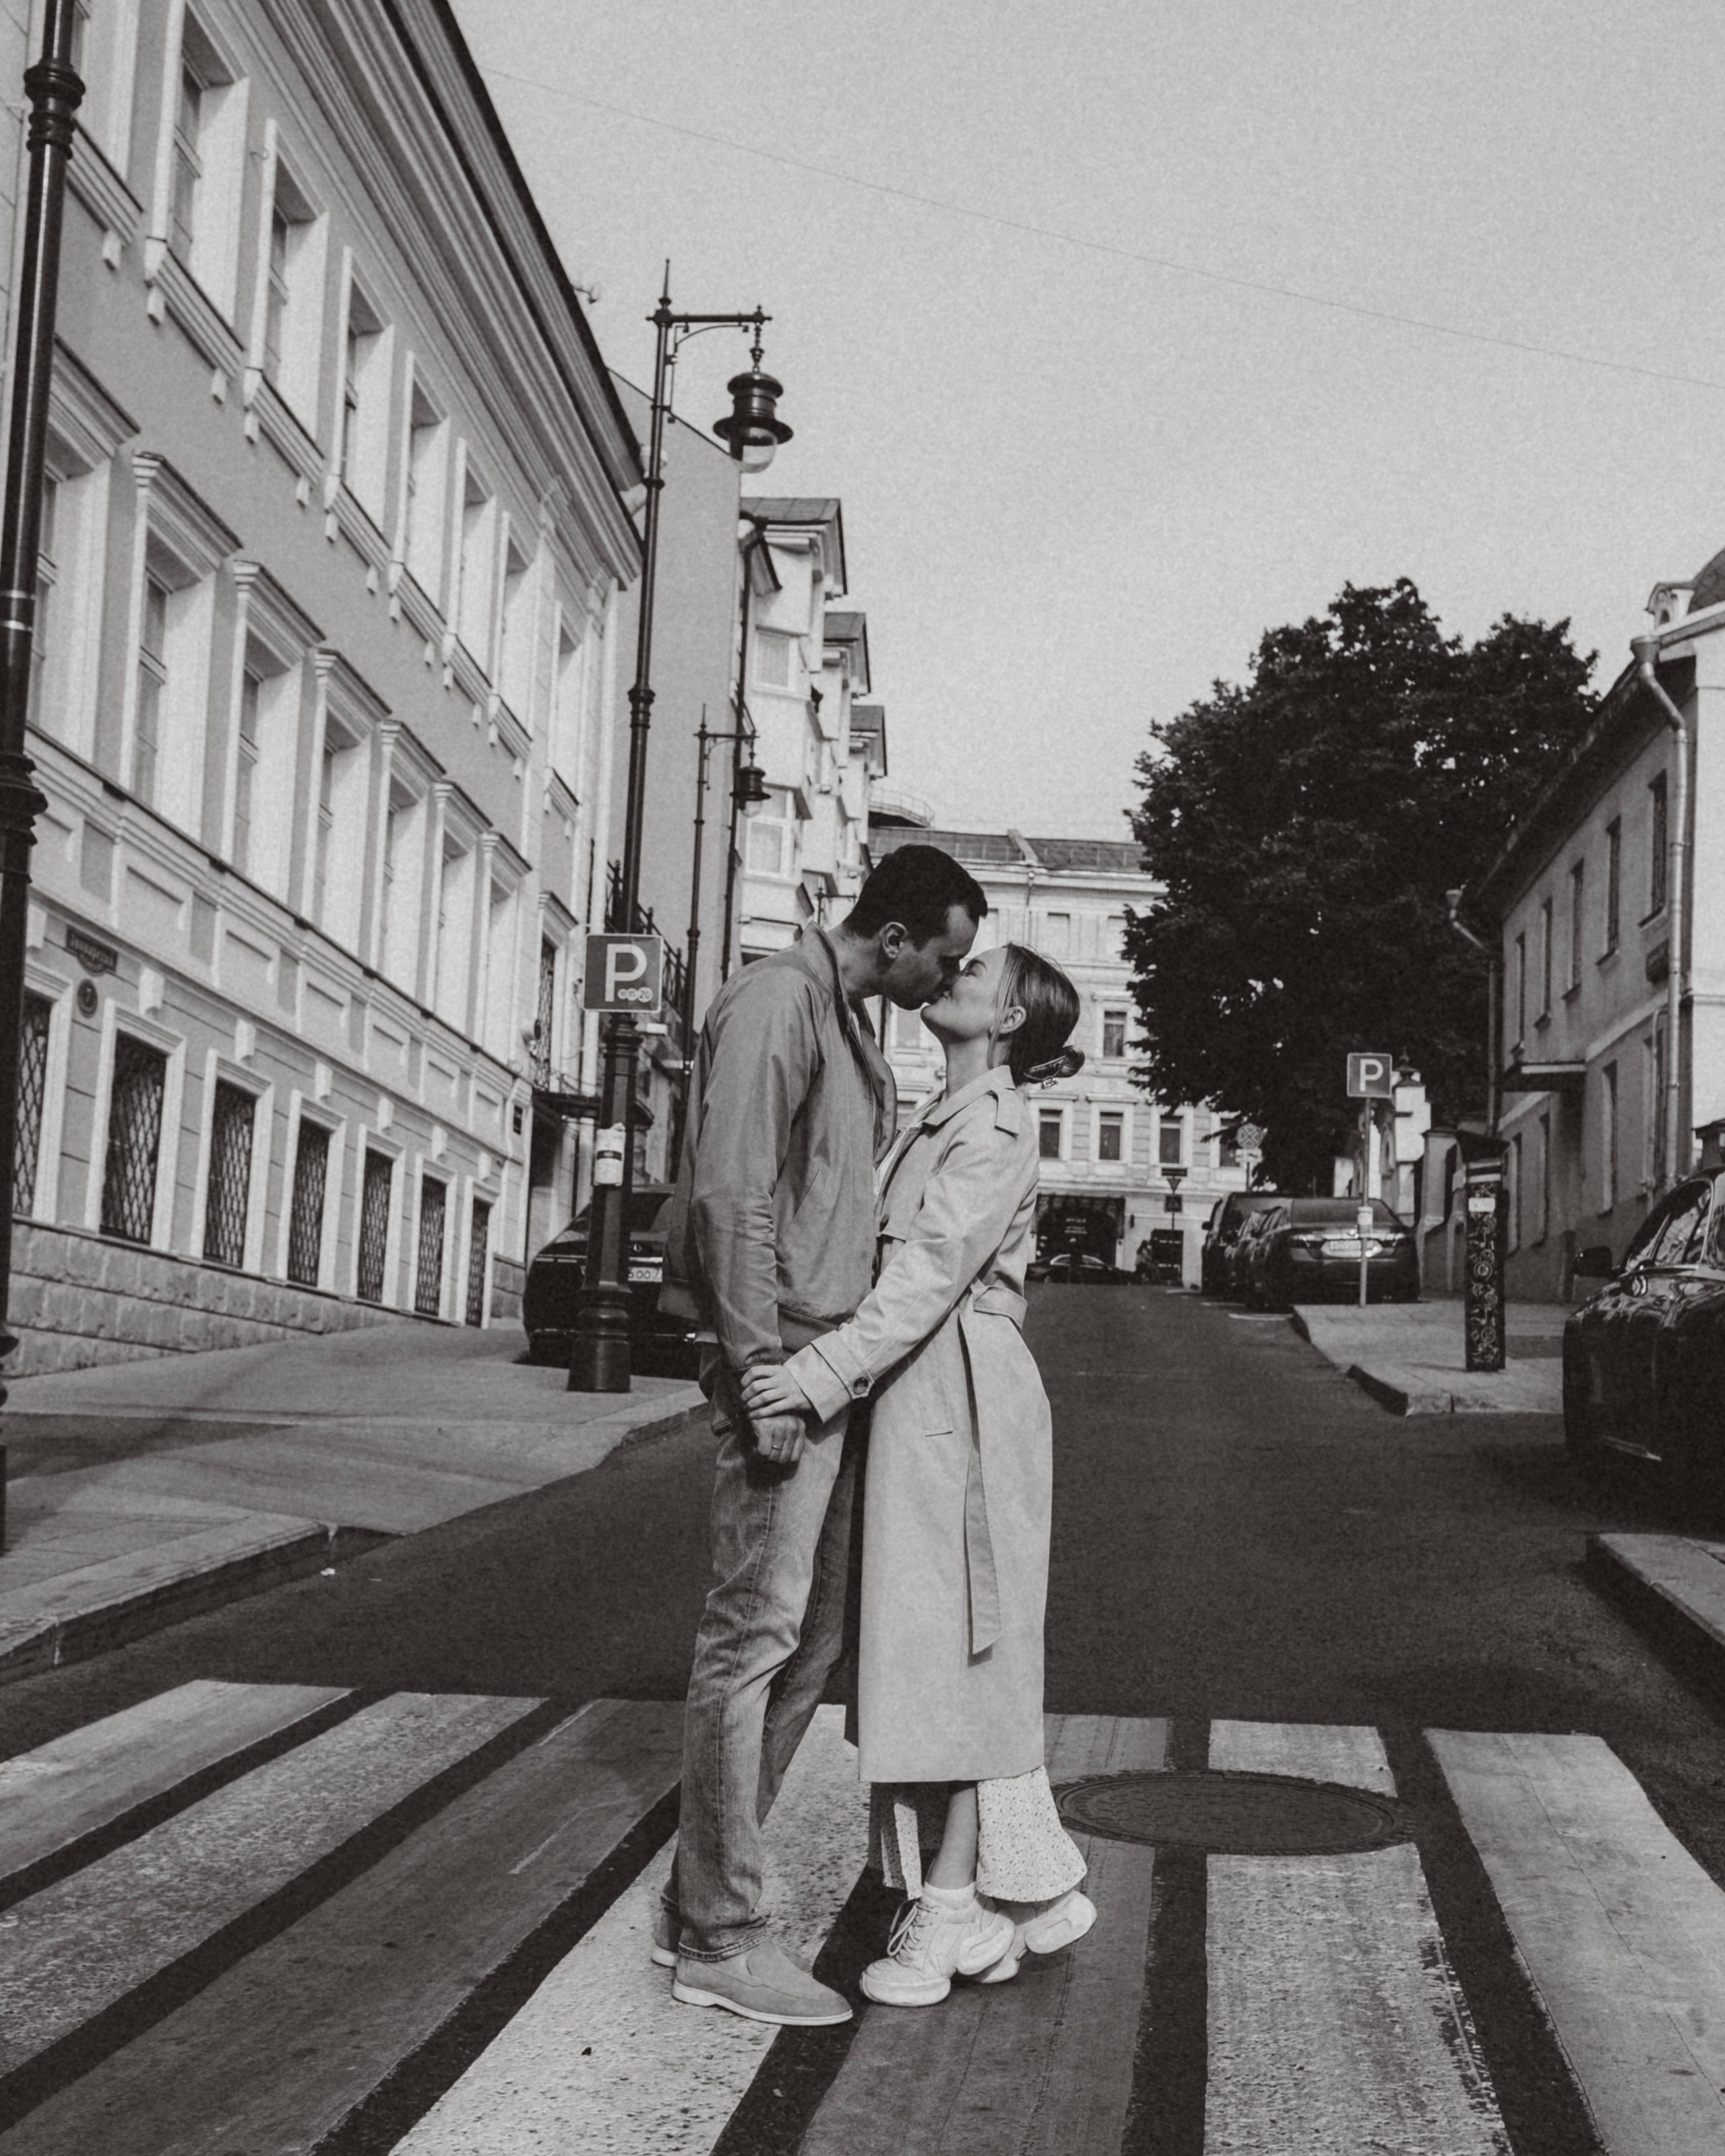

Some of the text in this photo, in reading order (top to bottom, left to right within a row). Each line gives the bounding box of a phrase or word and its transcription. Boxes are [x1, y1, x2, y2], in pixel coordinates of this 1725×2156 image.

[605, 944, 648, 1002] P
[639, 990, 651, 999] 20
[1359, 1058, 1384, 1092] P
